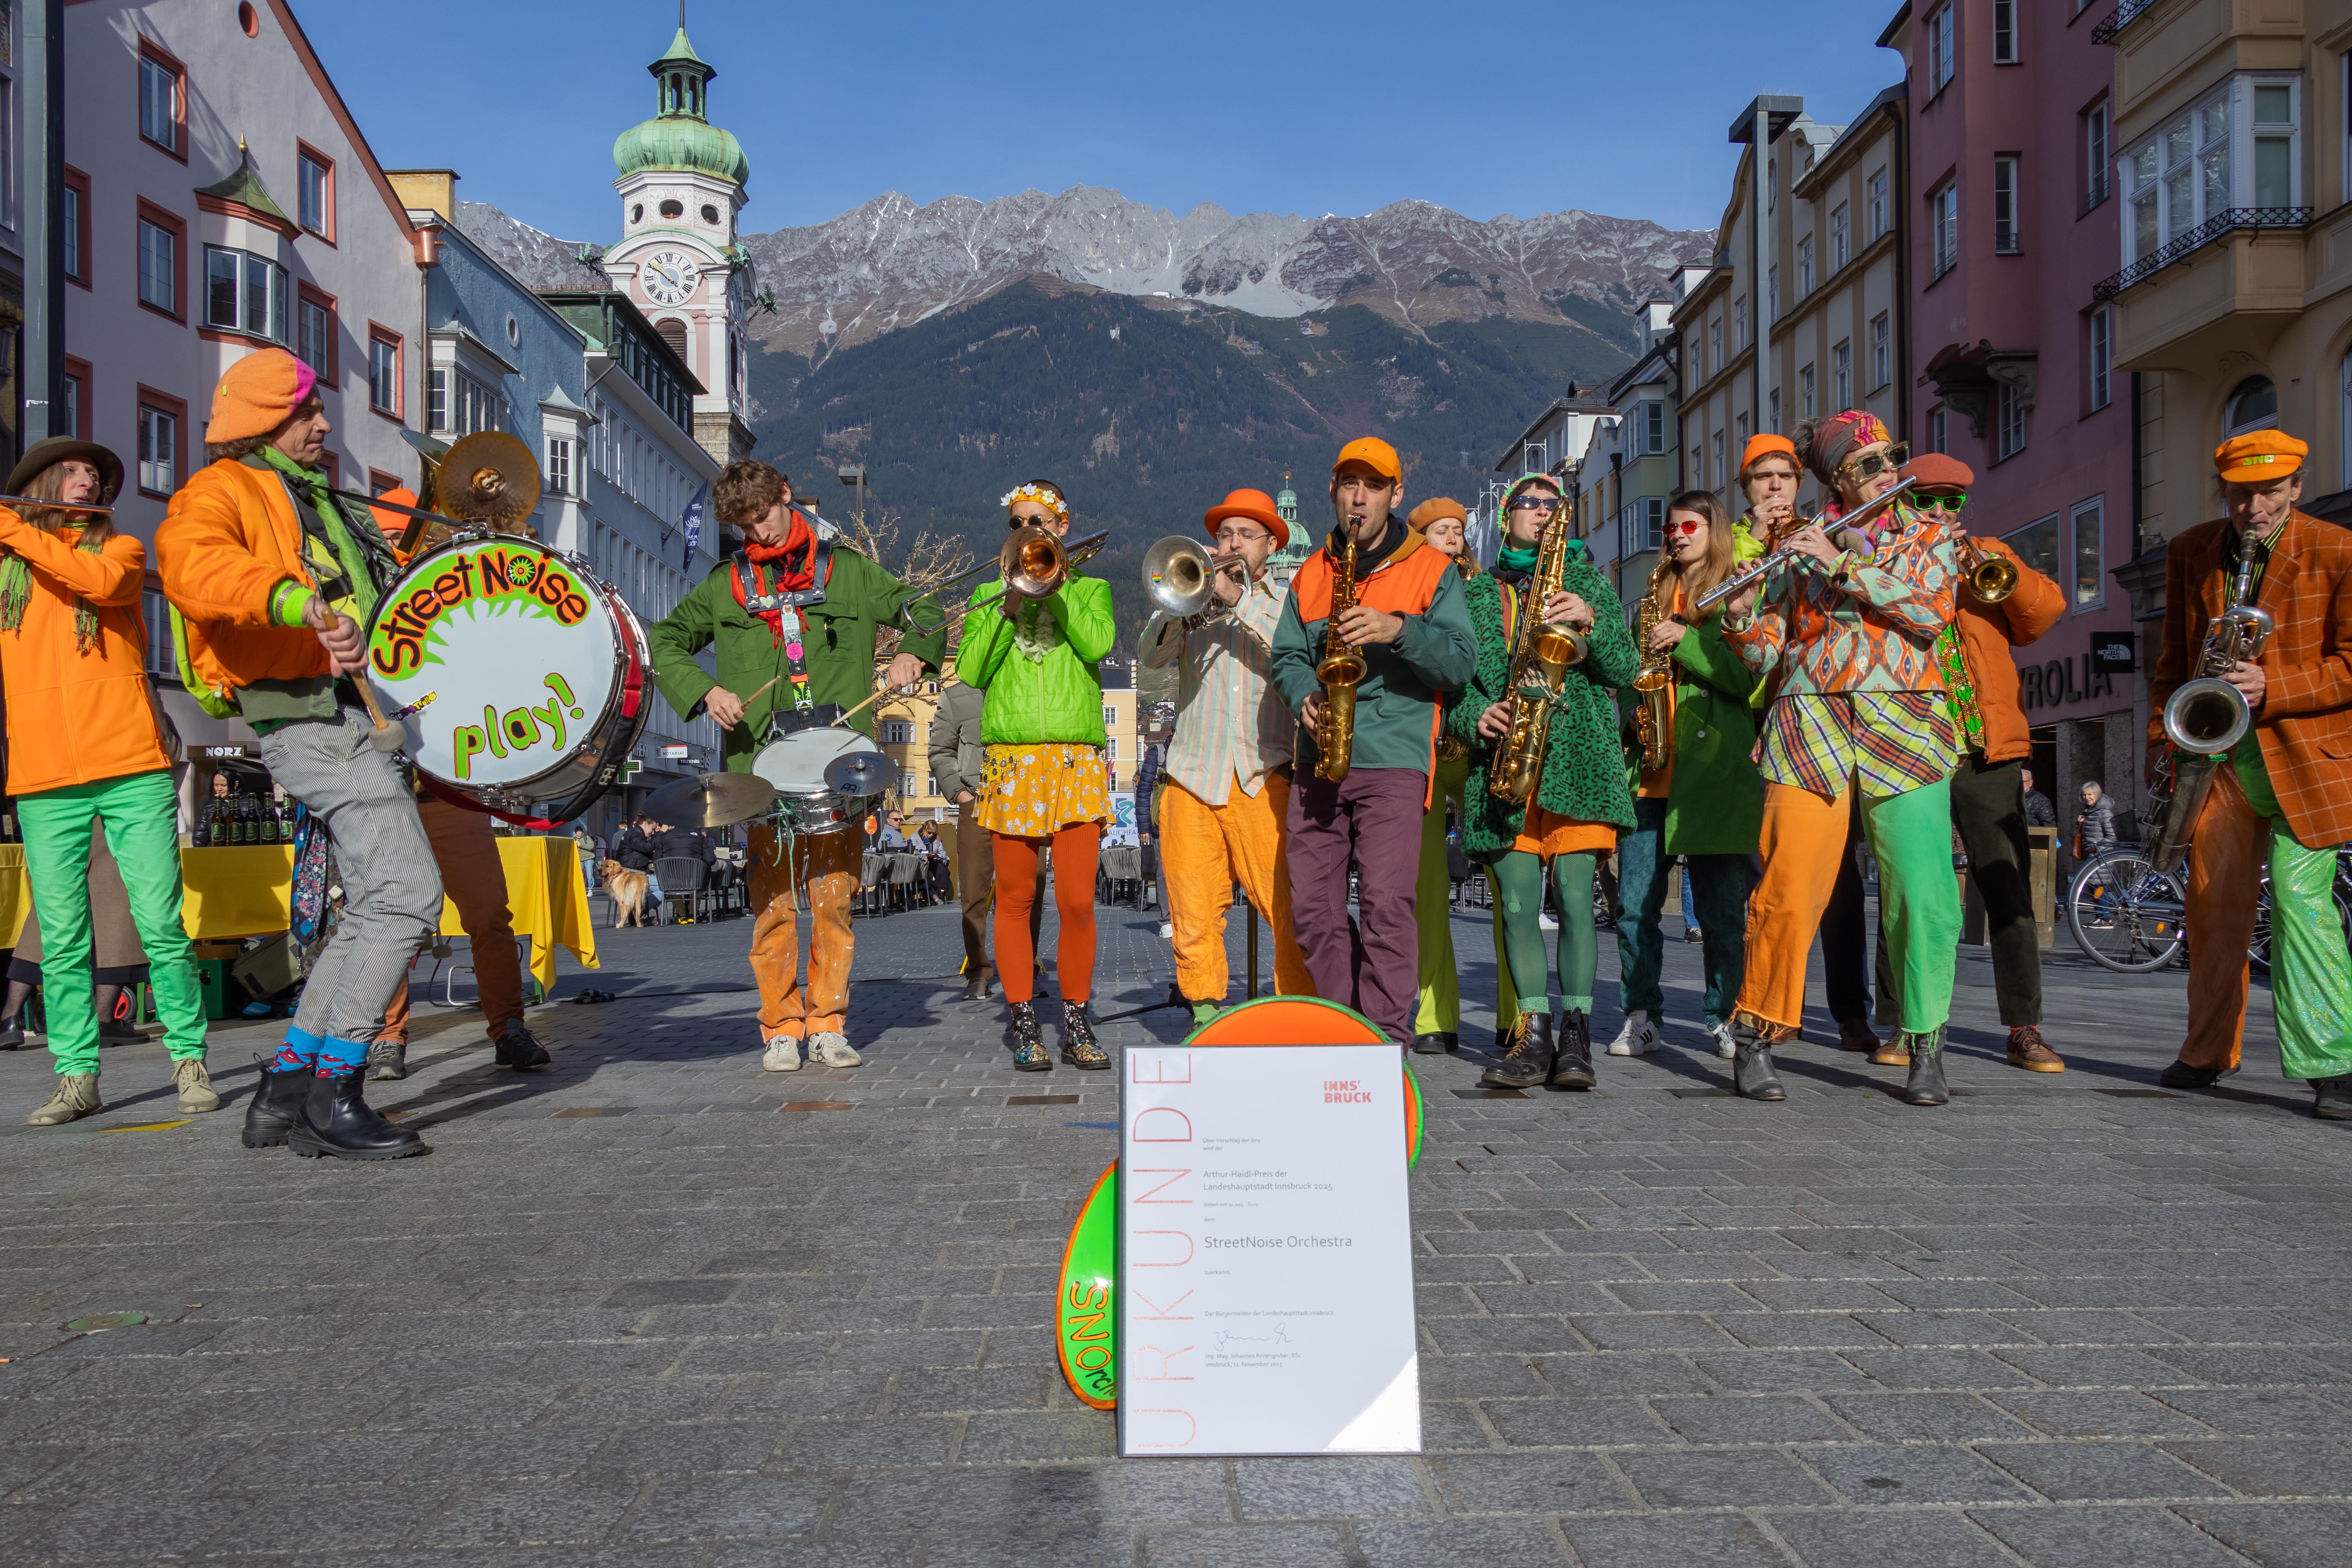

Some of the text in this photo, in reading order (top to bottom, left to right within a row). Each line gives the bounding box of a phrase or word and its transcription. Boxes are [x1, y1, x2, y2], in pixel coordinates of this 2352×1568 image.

[2243, 454, 2275, 466] SNO
[2019, 653, 2113, 709] ROLIA
[454, 672, 584, 781] play!
[206, 747, 242, 756] NORZ
[1324, 1092, 1372, 1104] BRUCK
[1203, 1183, 1273, 1191] Landeshauptstadt
[1275, 1182, 1312, 1190] Innsbruck
[1205, 1235, 1352, 1248] StreetNoise Orchestra
[1132, 1053, 1196, 1449] URKUNDE
